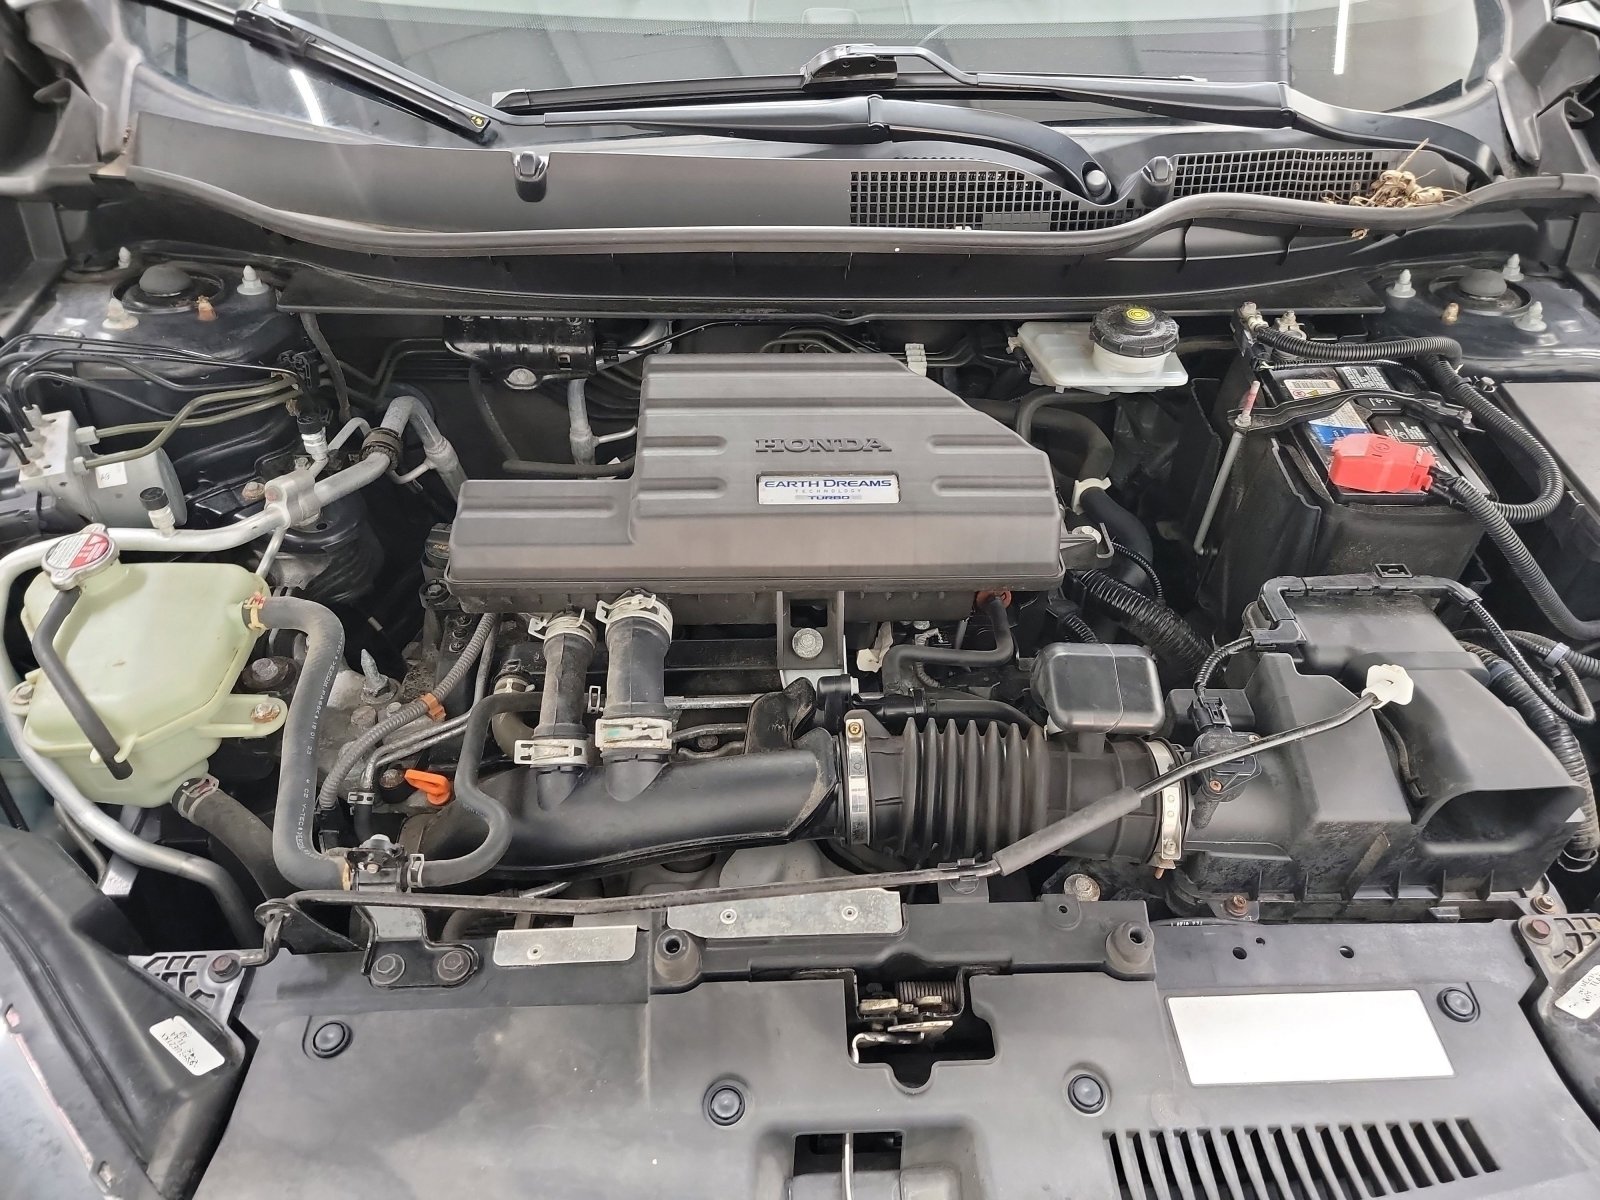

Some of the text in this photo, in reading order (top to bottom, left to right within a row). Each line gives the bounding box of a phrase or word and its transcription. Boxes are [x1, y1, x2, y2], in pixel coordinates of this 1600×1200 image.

[755, 438, 892, 453] HONDA
[764, 479, 892, 488] EARTH DREAMS
